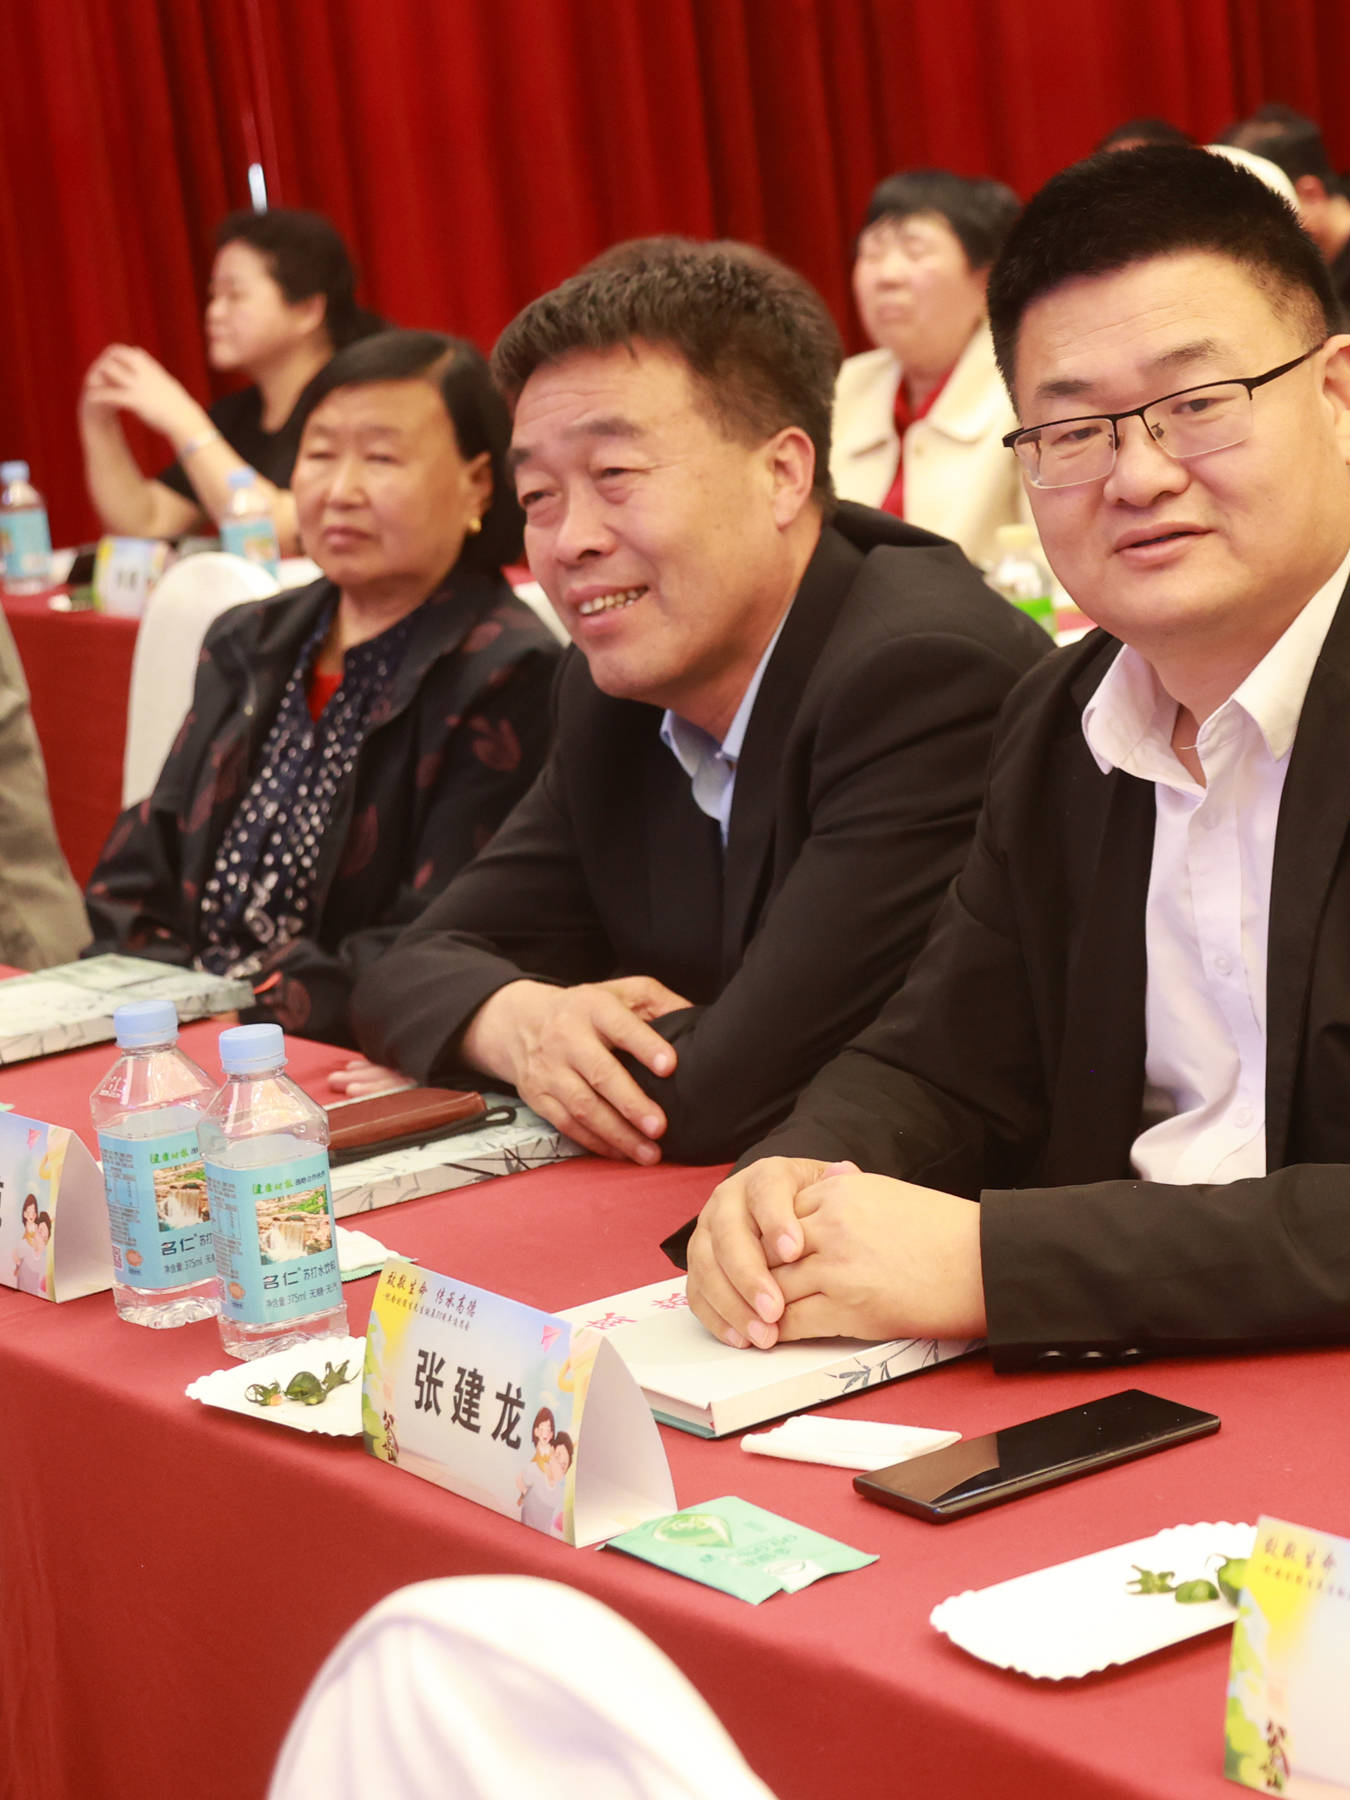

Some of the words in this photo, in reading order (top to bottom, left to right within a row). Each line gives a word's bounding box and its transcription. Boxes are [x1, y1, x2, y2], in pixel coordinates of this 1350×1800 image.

[161, 1237, 196, 1256] 名仁
[263, 1271, 298, 1290] 名仁
[414, 1348, 526, 1451] 张建龙
